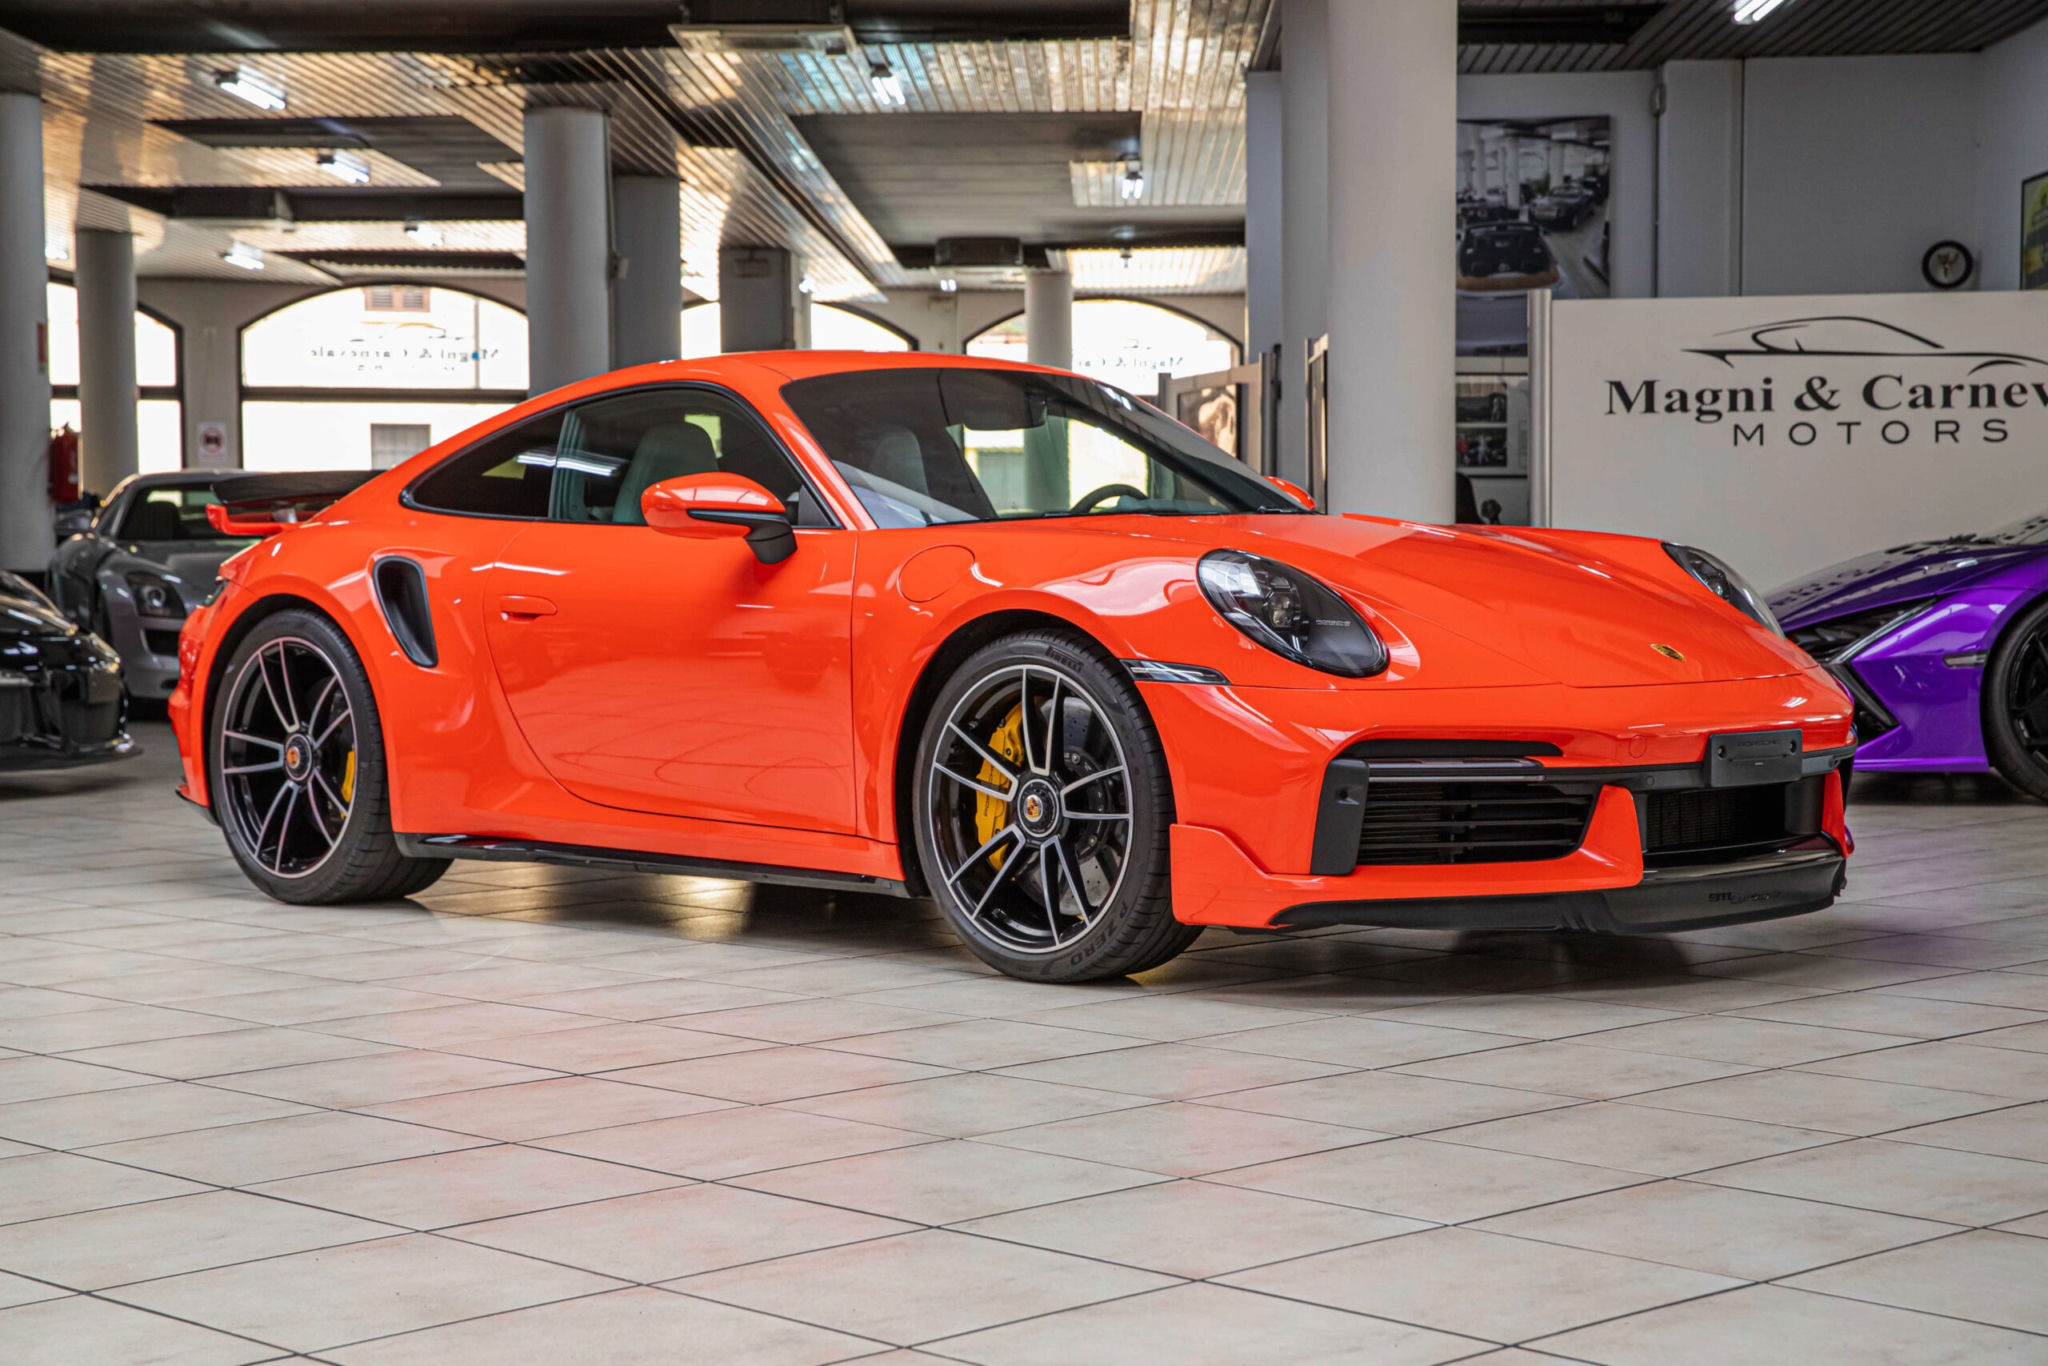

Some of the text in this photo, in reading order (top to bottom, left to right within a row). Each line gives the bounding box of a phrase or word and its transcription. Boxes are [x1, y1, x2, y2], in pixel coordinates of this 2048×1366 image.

[1605, 377, 1774, 423] Magni
[1793, 375, 1841, 412] &
[1733, 418, 2009, 447] MOTORS
